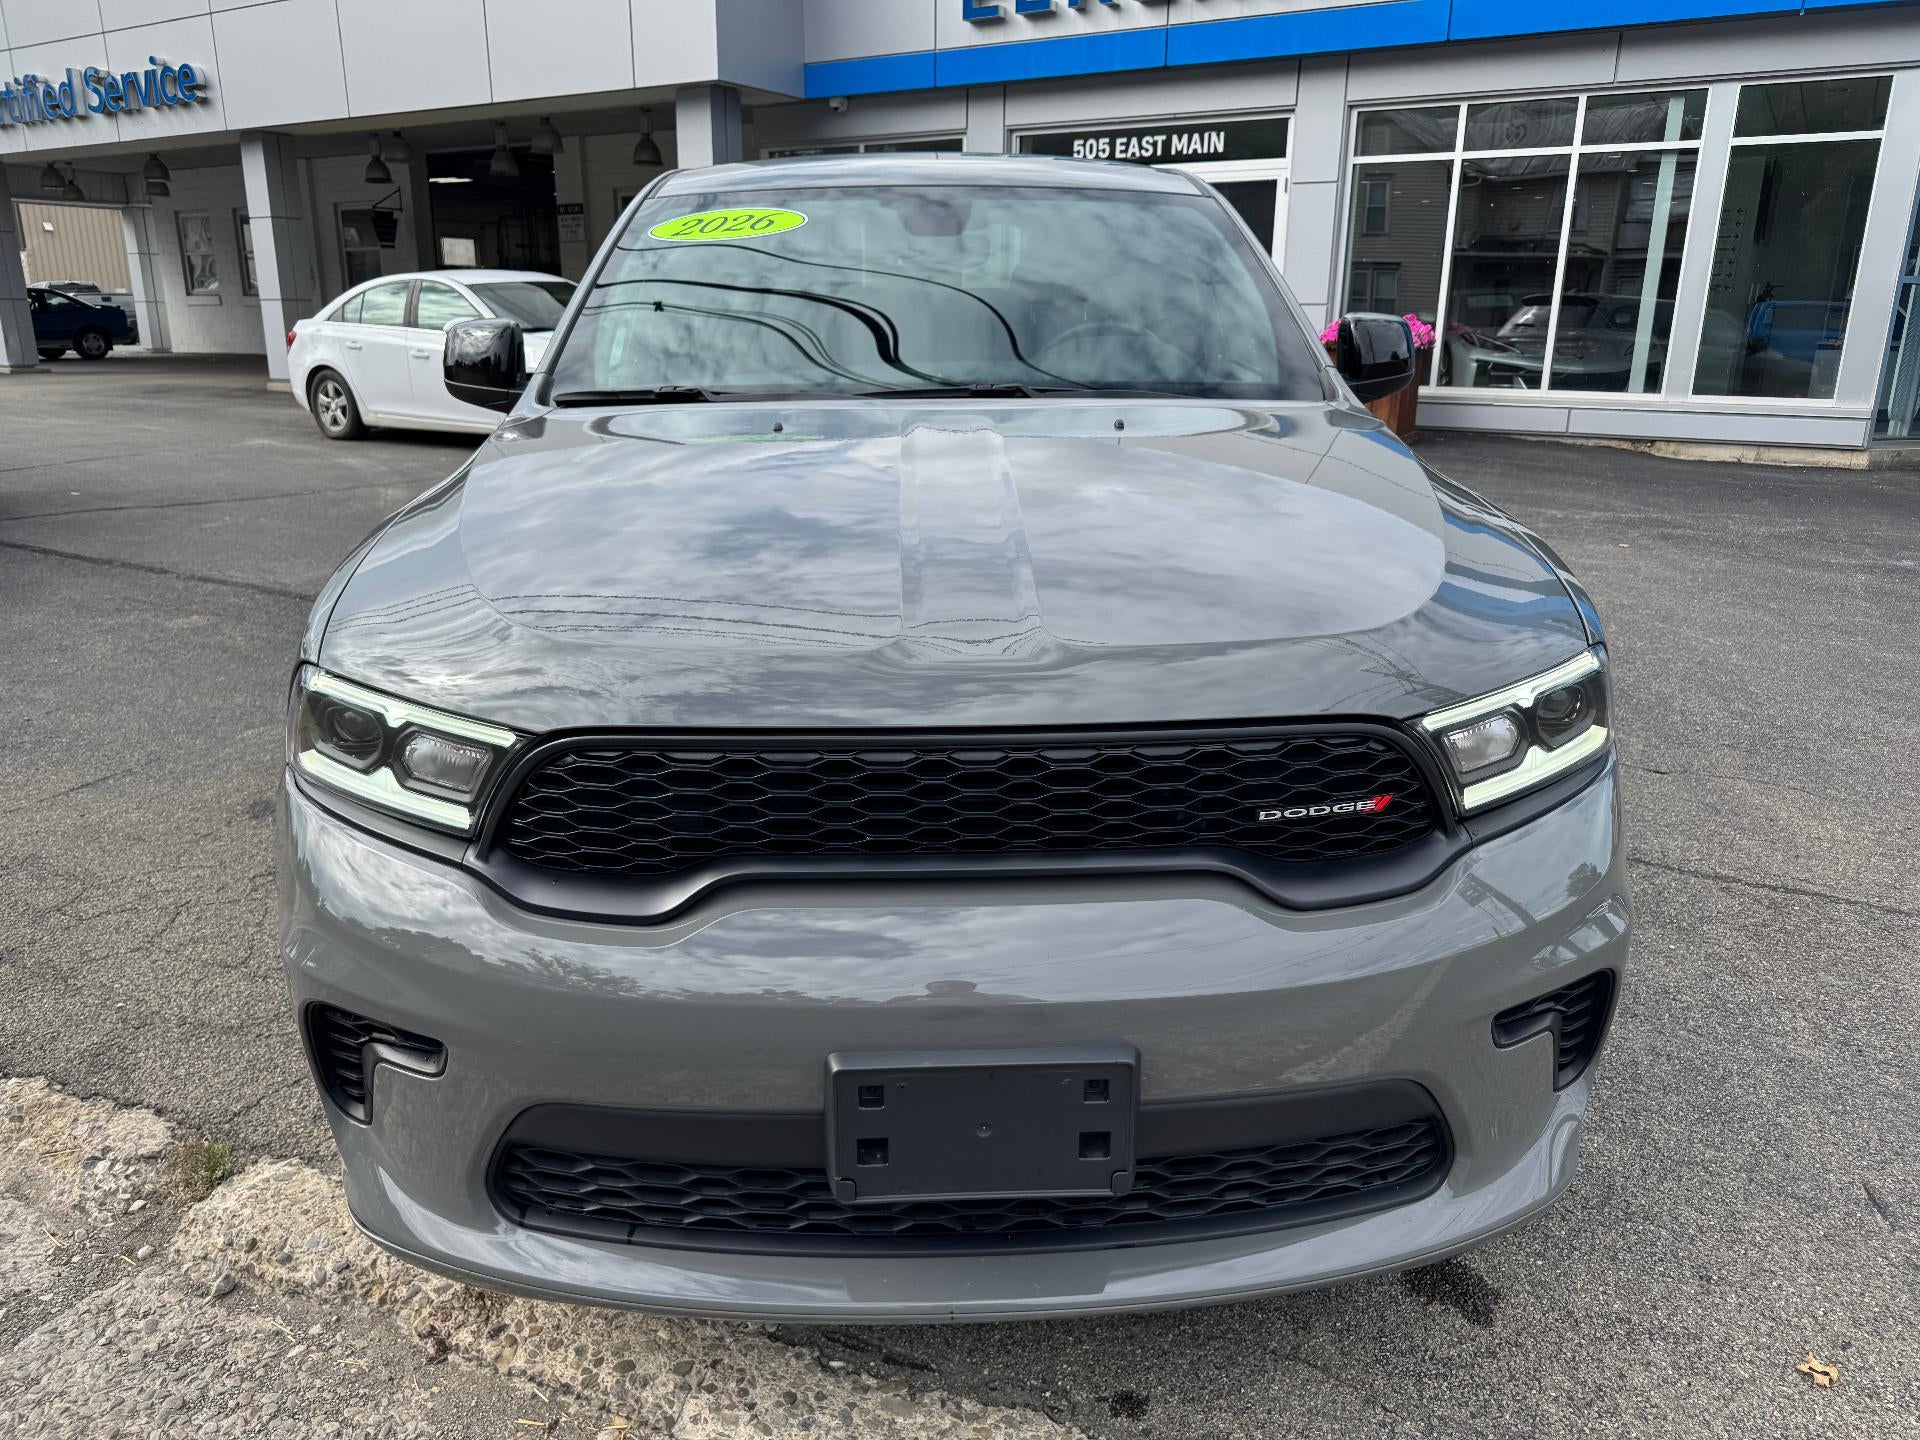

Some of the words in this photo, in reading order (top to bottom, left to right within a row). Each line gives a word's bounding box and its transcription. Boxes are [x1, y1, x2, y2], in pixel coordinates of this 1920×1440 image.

[83, 56, 201, 113] Service
[1072, 138, 1110, 159] 505
[1114, 135, 1166, 159] EAST
[1170, 131, 1225, 156] MAIN
[671, 212, 784, 237] 2026
[1258, 800, 1376, 821] DODGE
